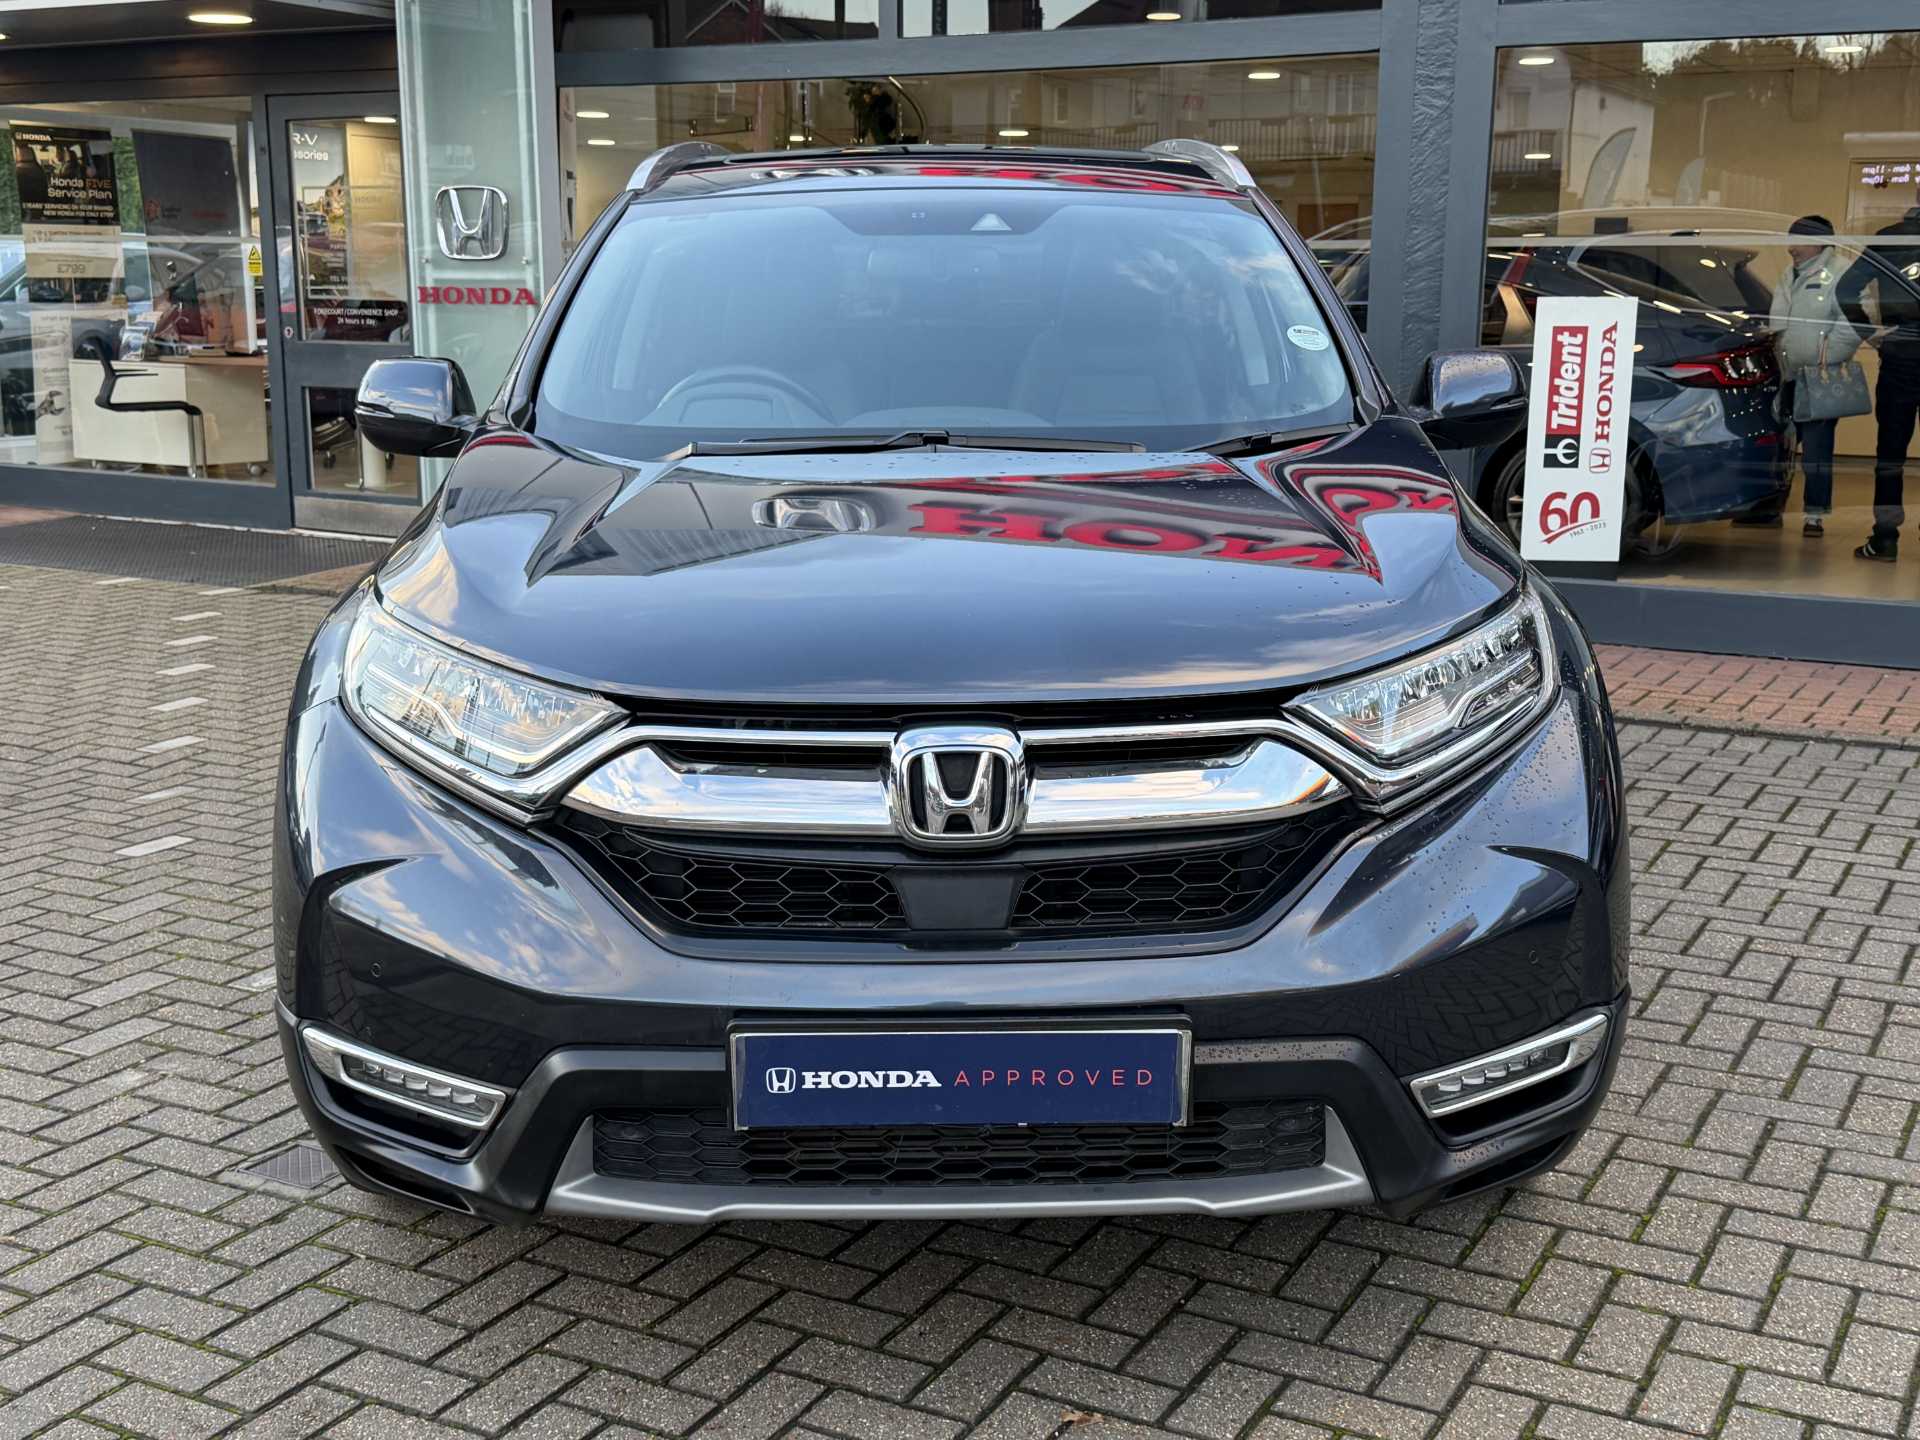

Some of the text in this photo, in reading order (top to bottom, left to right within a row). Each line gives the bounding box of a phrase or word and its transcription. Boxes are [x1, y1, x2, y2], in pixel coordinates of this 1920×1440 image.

[22, 133, 51, 141] HONDA
[50, 177, 112, 188] Honda FIVE
[47, 187, 112, 199] Service Plan
[57, 264, 86, 273] £799
[417, 286, 538, 305] HONDA
[345, 317, 360, 325] hours
[1551, 331, 1584, 429] Trident
[1595, 320, 1618, 443] HONDA
[1539, 491, 1600, 537] 60
[801, 1070, 942, 1088] HONDA
[953, 1069, 1154, 1087] APPROVED
